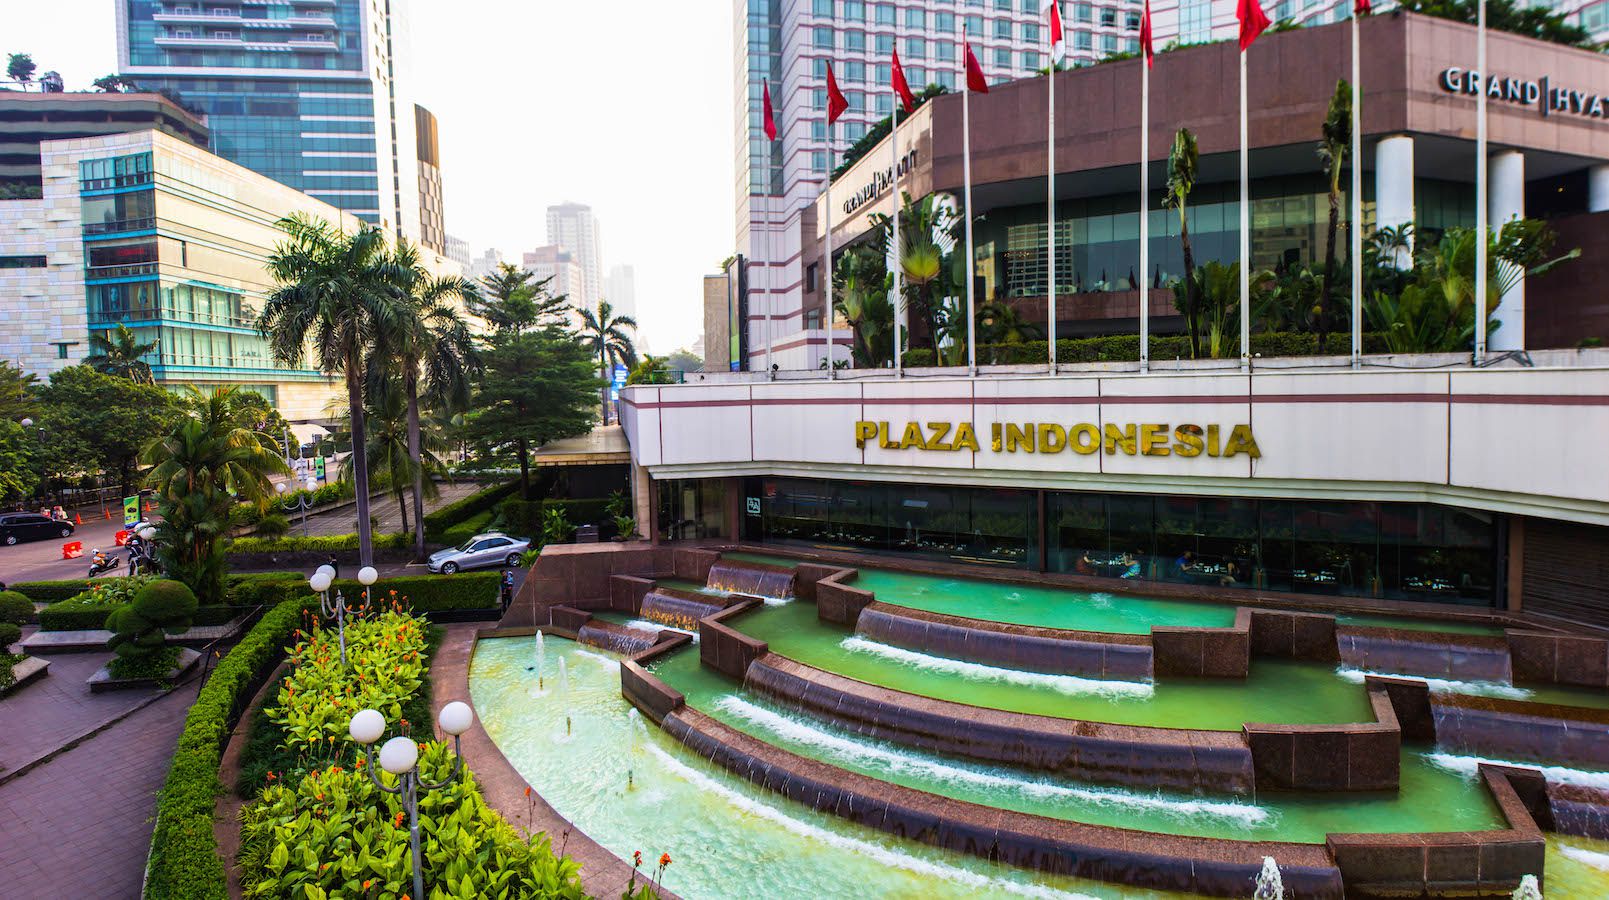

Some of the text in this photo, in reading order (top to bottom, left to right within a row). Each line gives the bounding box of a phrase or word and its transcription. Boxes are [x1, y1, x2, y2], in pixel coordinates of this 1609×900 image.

[1439, 67, 1541, 105] GRAND
[856, 420, 1262, 459] PLAZA INDONESIA
